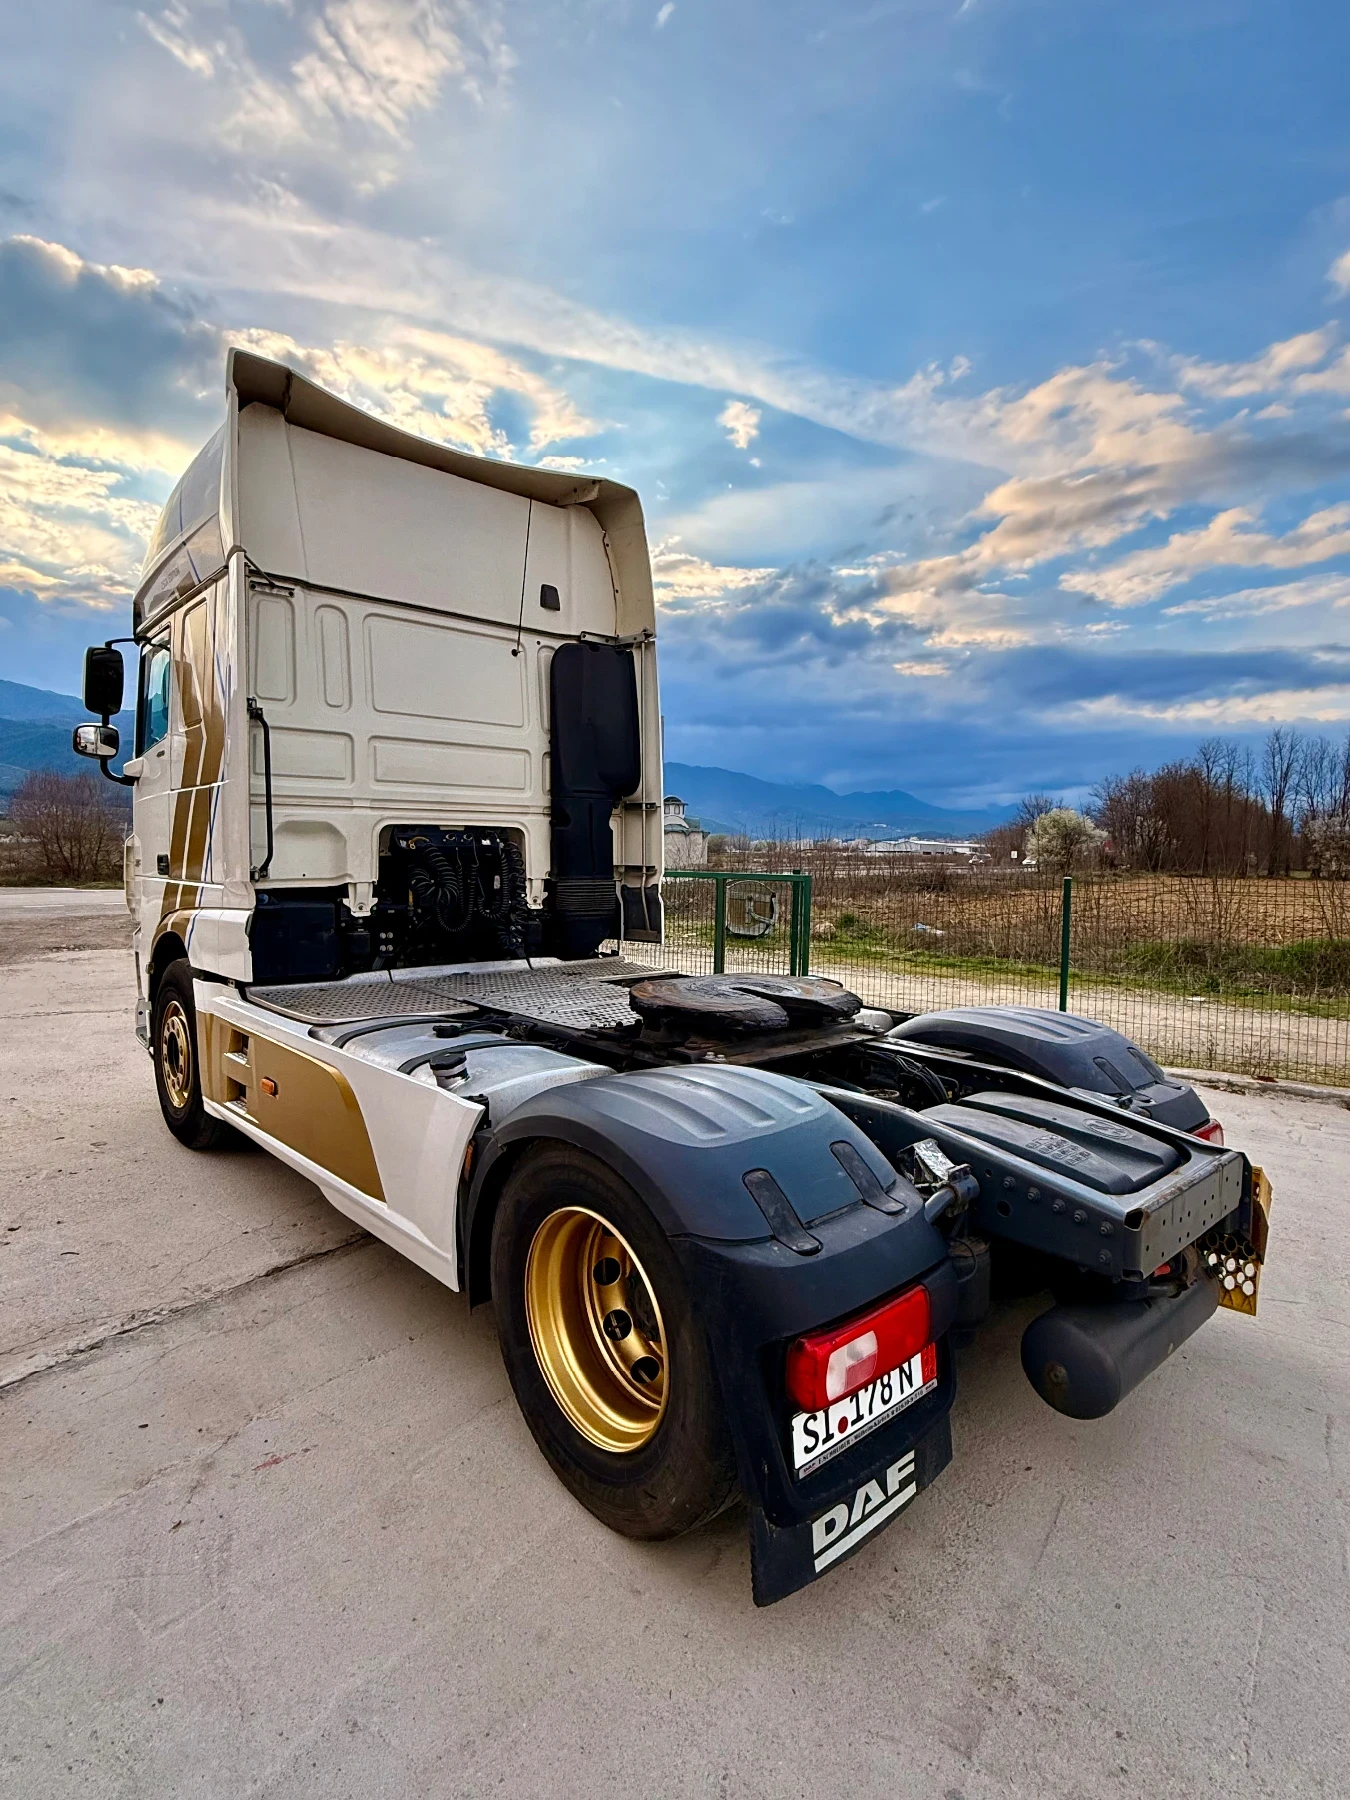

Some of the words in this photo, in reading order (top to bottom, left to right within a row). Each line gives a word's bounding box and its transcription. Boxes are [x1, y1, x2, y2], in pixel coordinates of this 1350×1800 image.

[803, 1407, 834, 1454] SI
[850, 1374, 892, 1427] 178
[899, 1361, 914, 1395] N
[812, 1450, 914, 1554] DAF
